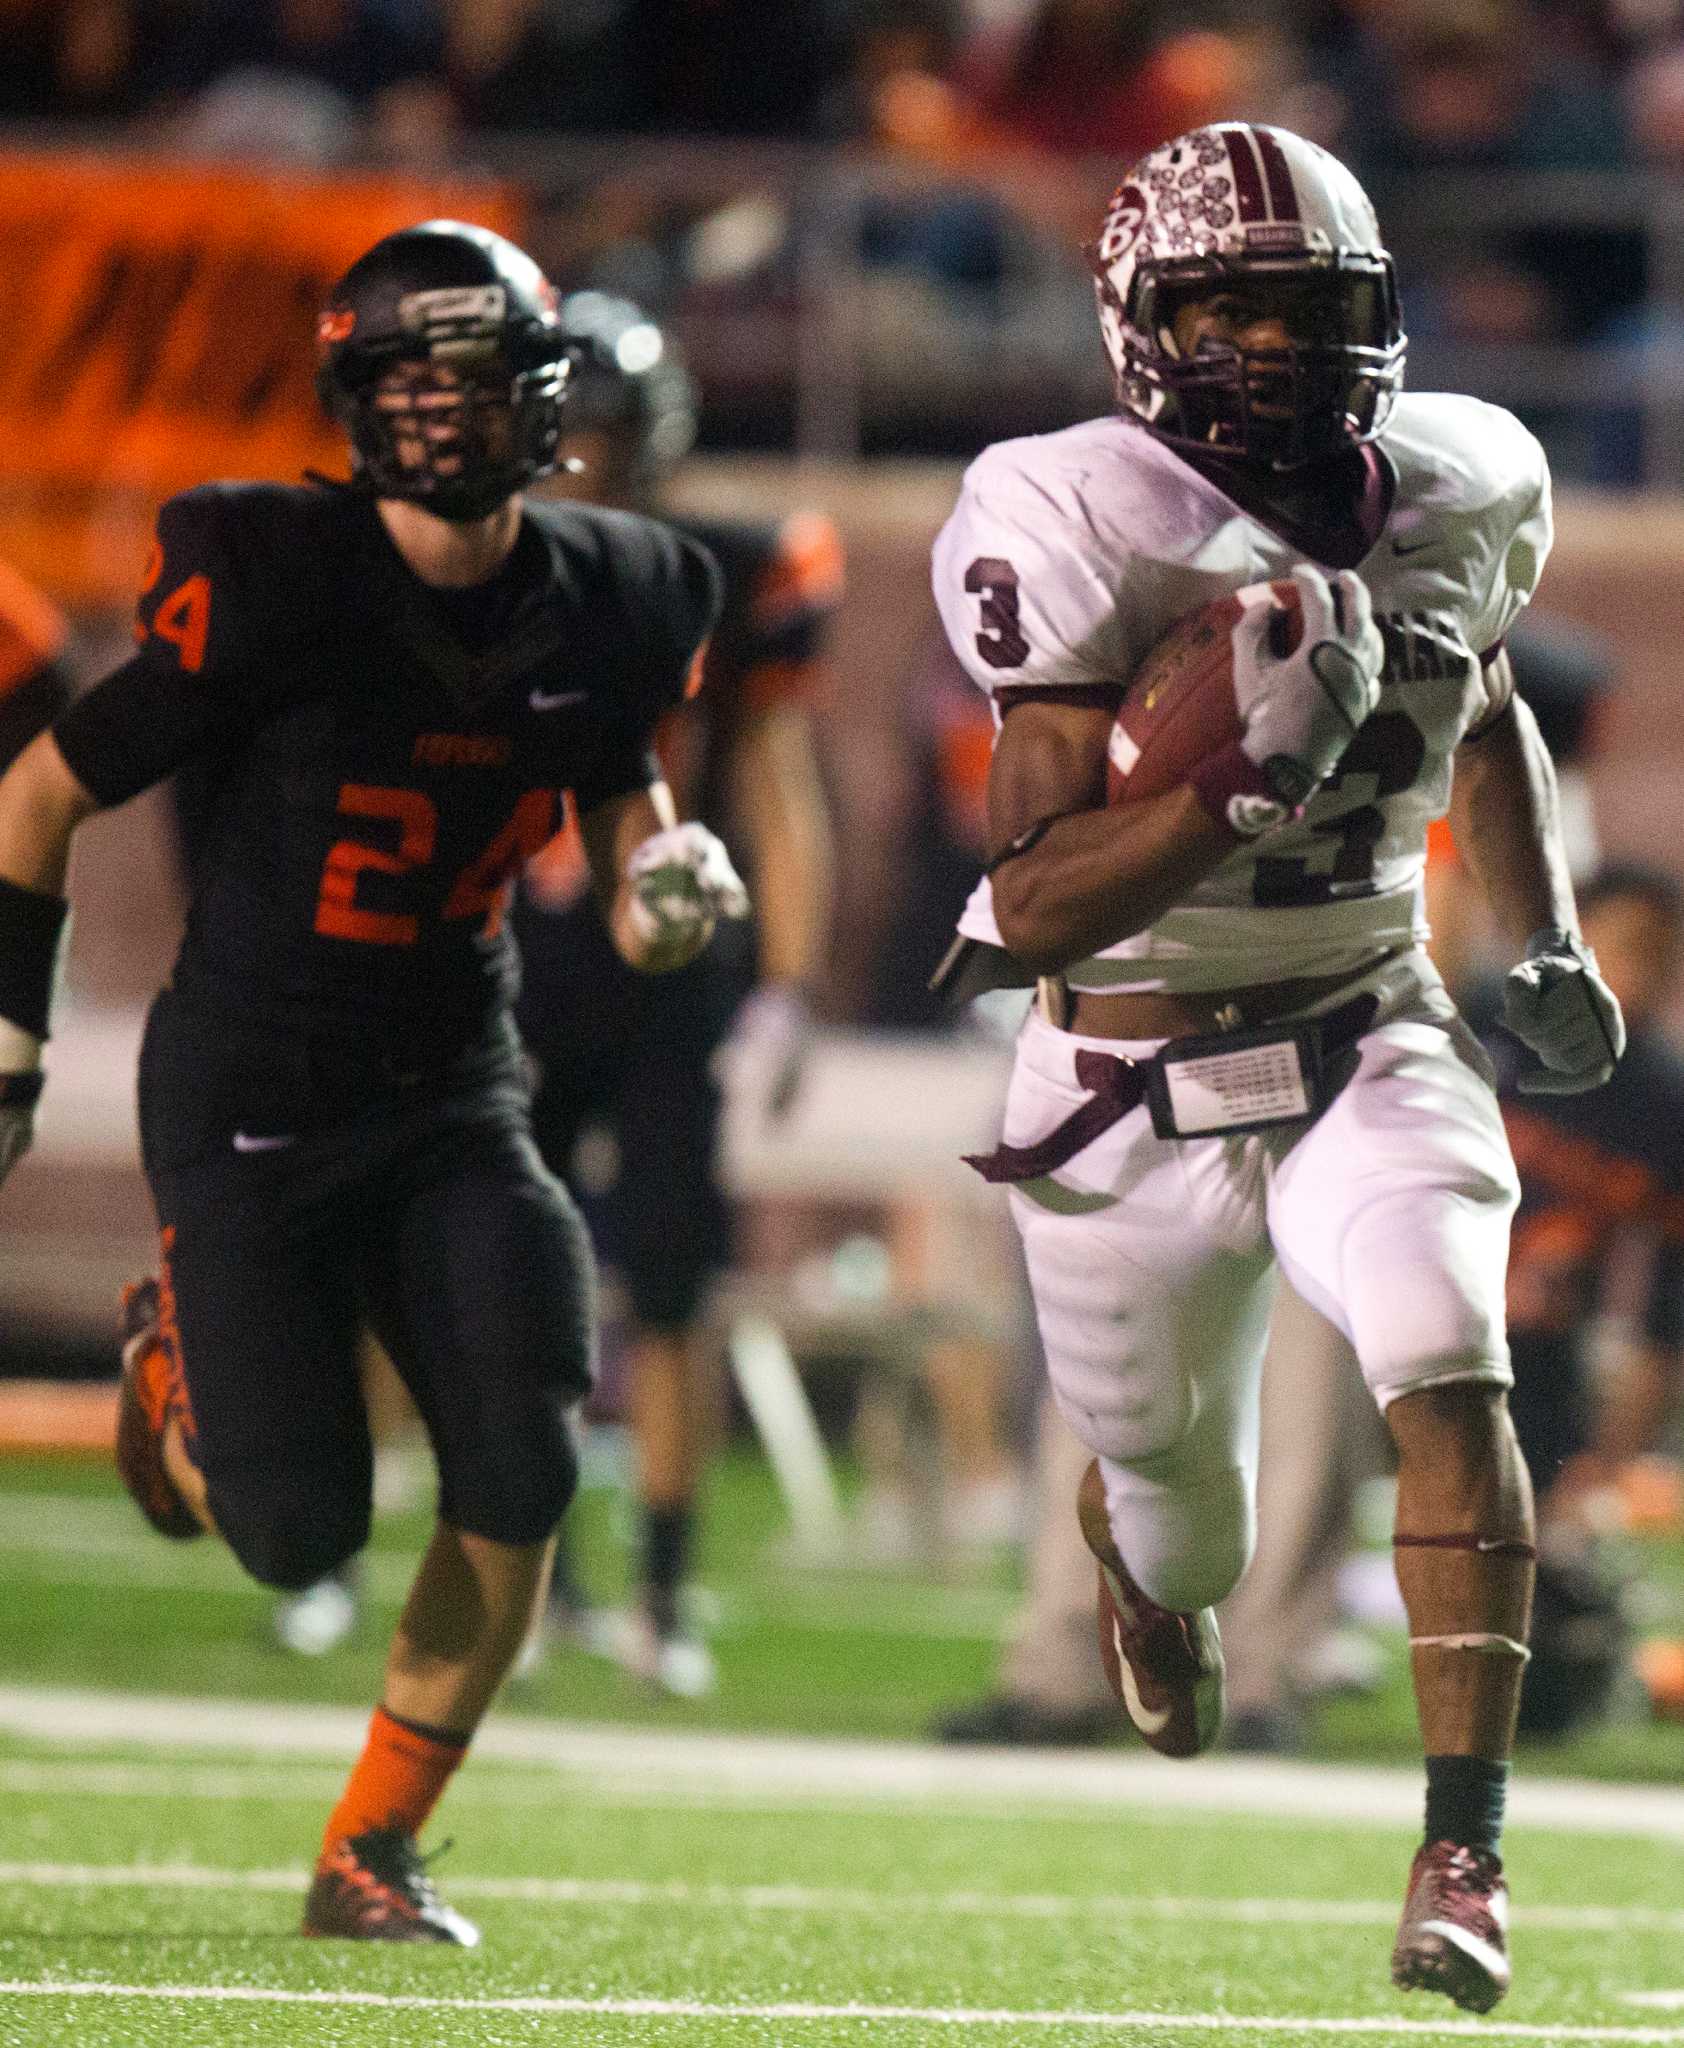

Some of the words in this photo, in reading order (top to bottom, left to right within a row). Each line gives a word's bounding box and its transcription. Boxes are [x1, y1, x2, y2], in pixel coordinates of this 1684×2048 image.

[1100, 207, 1142, 260] B
[965, 556, 1031, 669] 3
[314, 783, 558, 944] 24
[1253, 711, 1426, 907] 3
